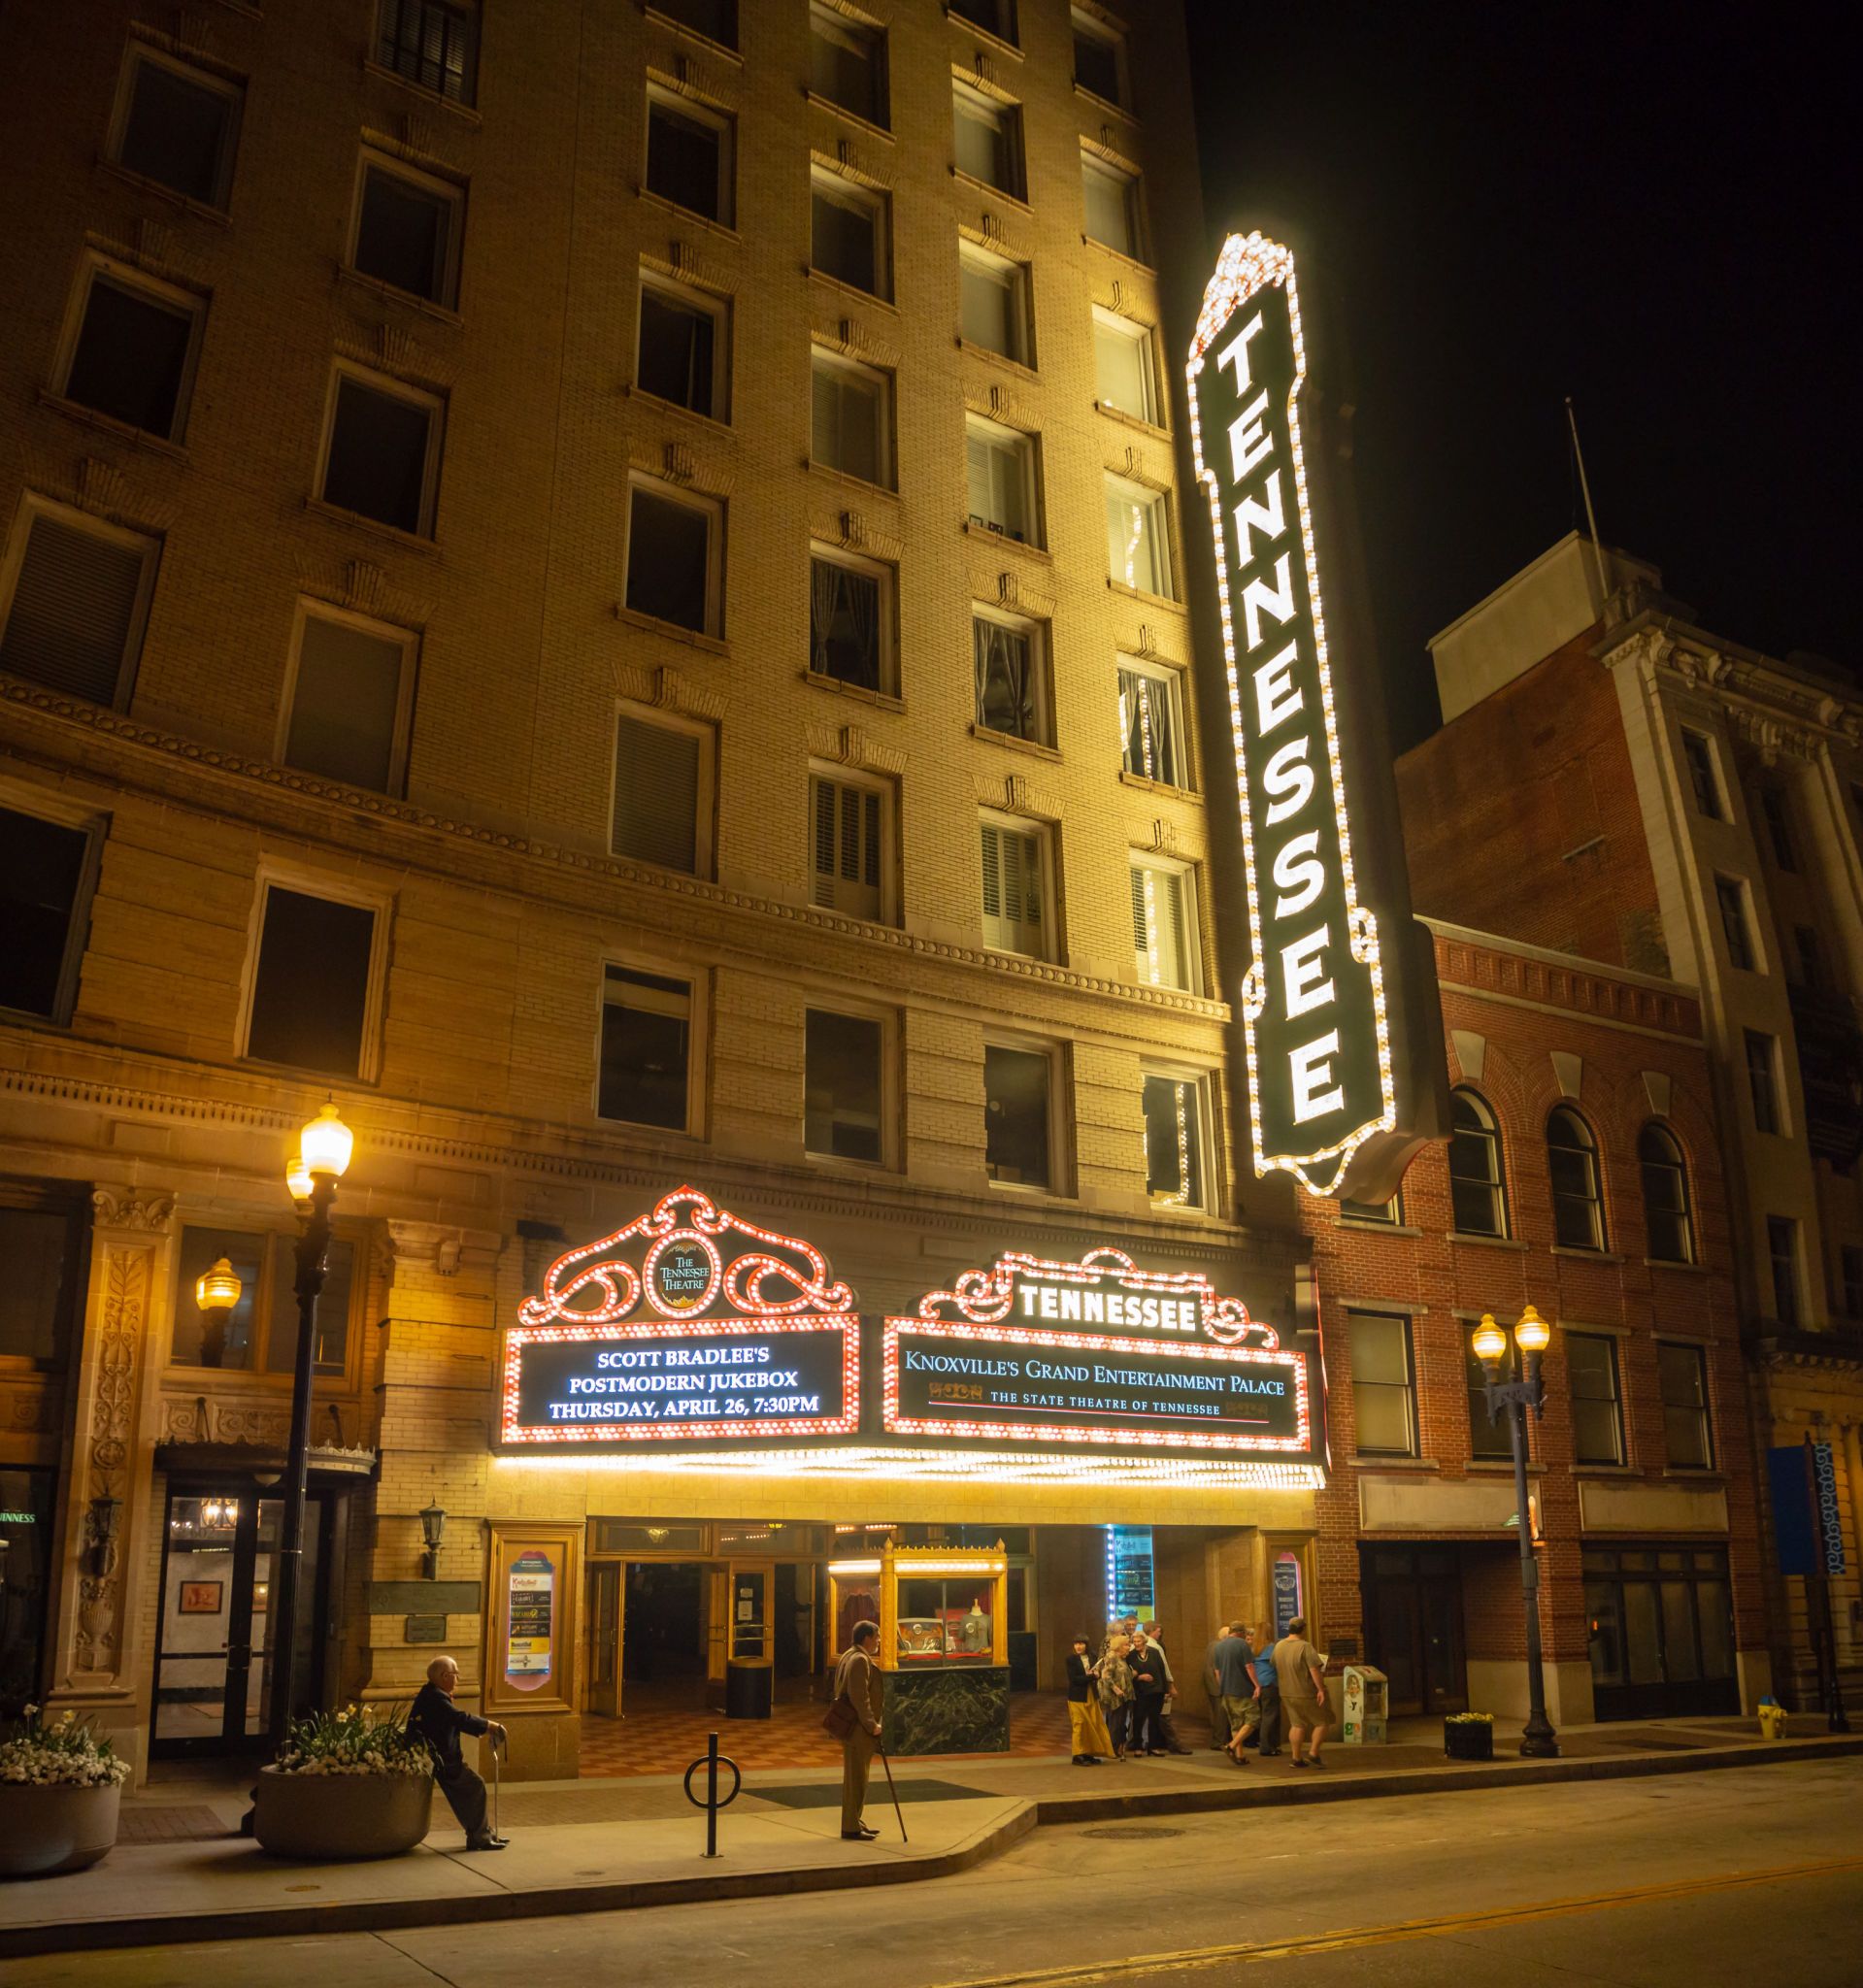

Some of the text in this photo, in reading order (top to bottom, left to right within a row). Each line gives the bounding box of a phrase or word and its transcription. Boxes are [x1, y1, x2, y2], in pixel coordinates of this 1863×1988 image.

[1217, 310, 1345, 1126] TENNESSEE
[660, 1267, 710, 1279] TENNESSEE
[676, 1257, 693, 1268] THE
[663, 1278, 705, 1291] THEATRE
[1019, 1283, 1197, 1333] TENNESSEE
[597, 1347, 770, 1369] SCOTT BRADLEE'S
[569, 1371, 799, 1394] POSTMODERN JUKEBOX
[905, 1350, 1285, 1396] KNOXVILLE'S GRAND ENTERTAINMENT PALACE
[549, 1396, 819, 1419] THURSDAY, APRIL 26, 7:30PM
[990, 1391, 1220, 1415] THE STATE THEATRE OF TENNESSEE
